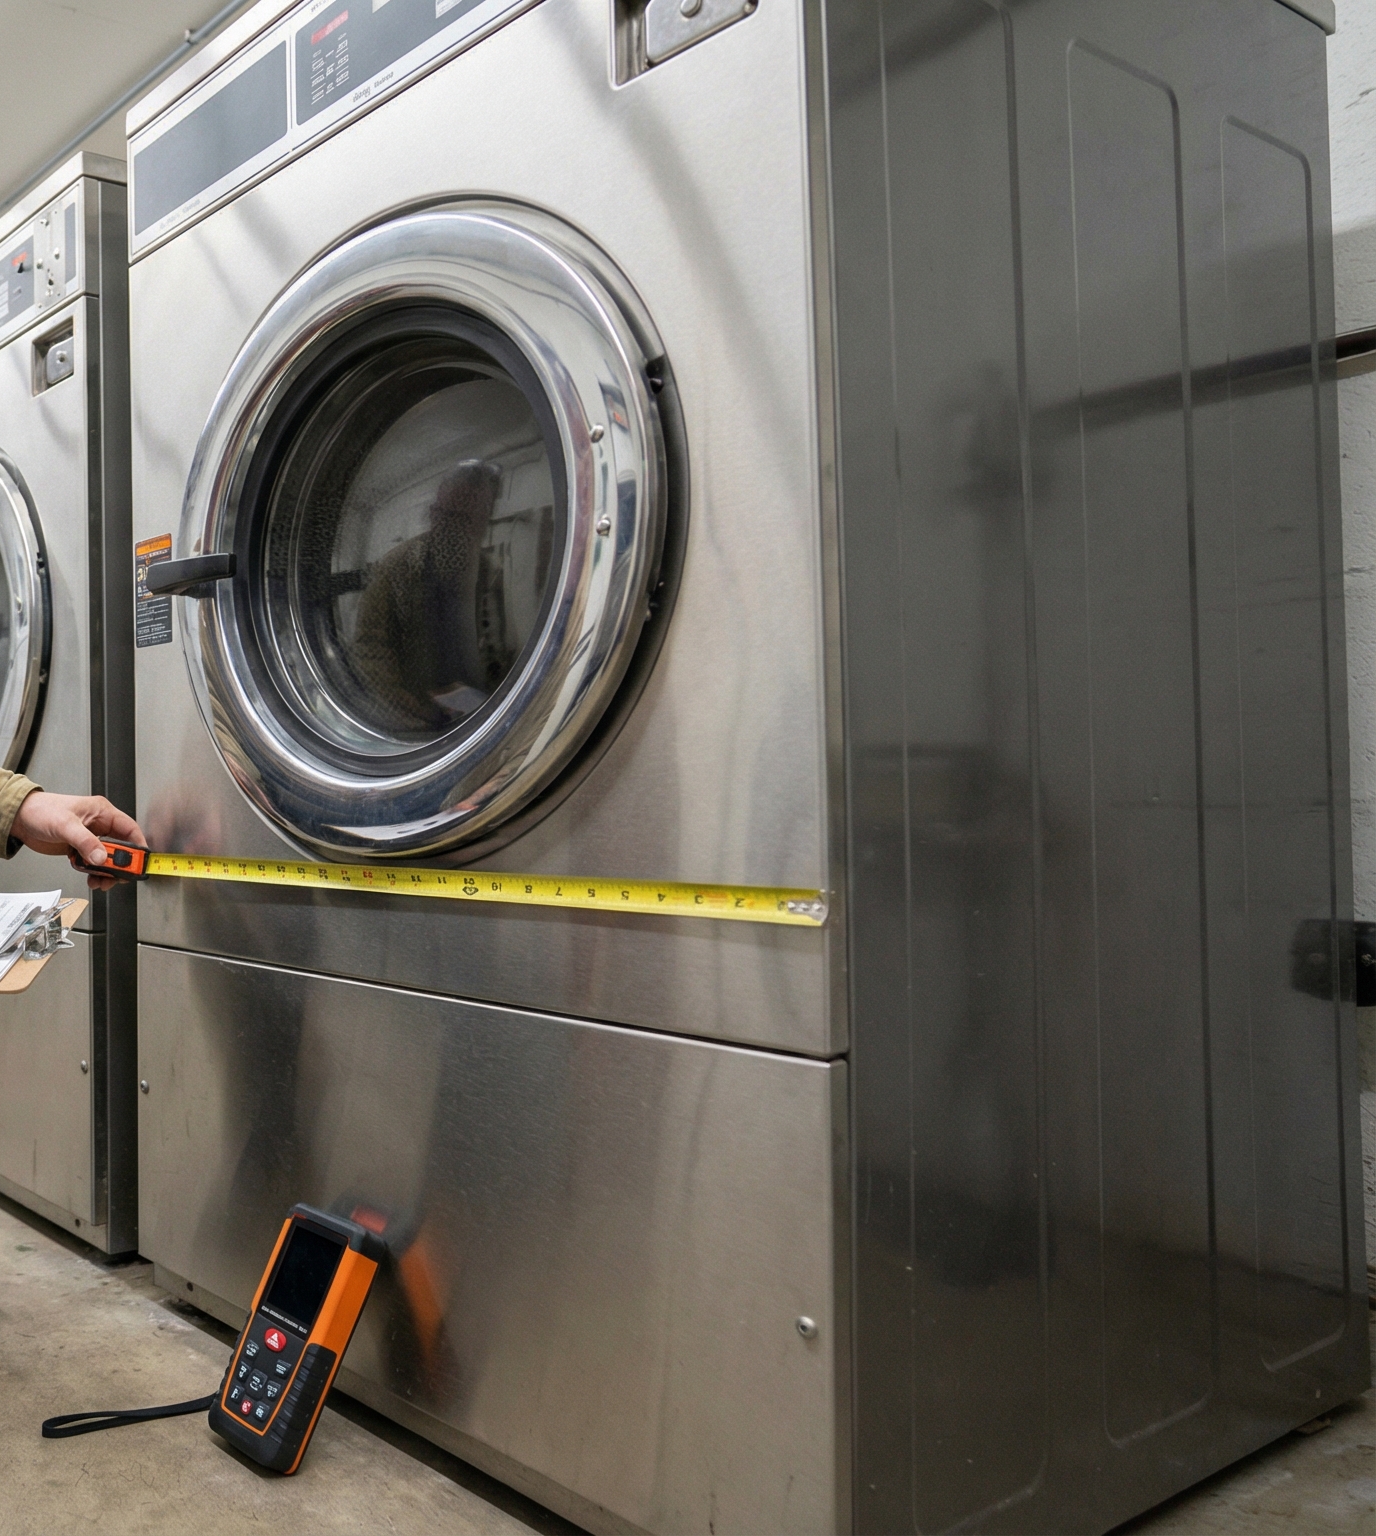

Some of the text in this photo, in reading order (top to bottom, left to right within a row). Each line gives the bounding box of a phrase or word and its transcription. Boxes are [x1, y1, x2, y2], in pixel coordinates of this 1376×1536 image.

[555, 887, 562, 896] 7
[621, 890, 629, 900] 5
[658, 893, 666, 902] 4
